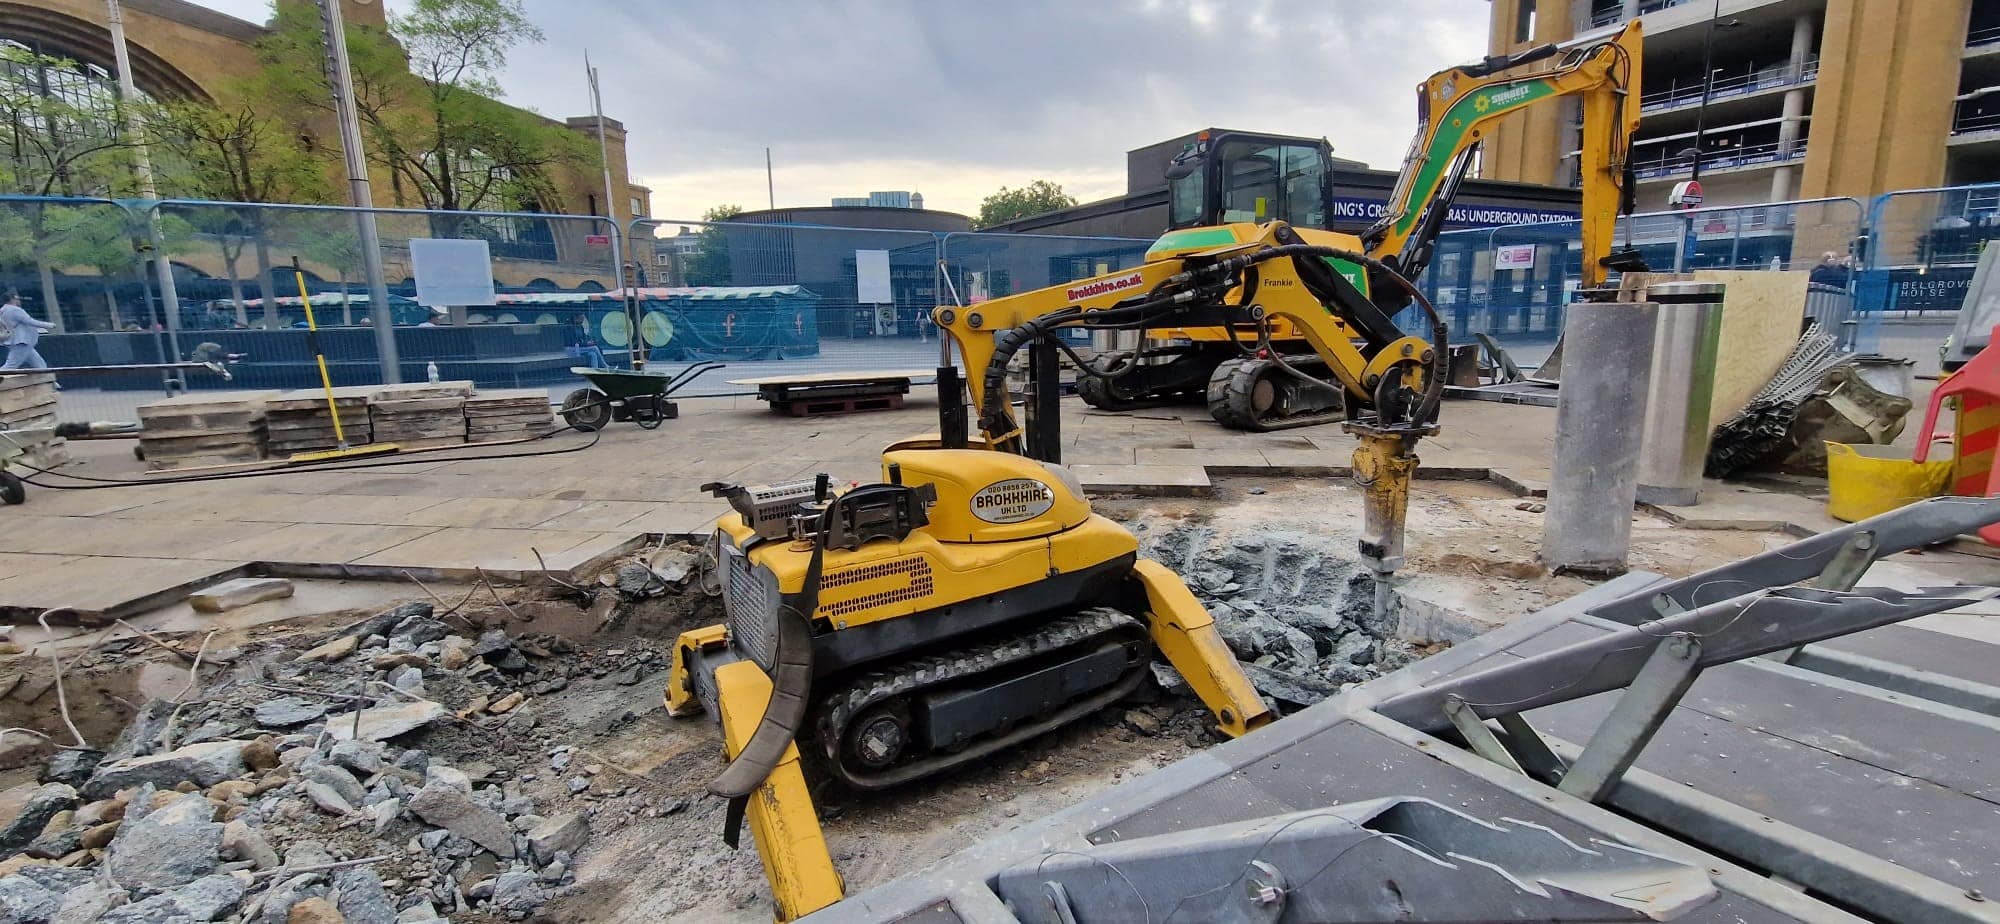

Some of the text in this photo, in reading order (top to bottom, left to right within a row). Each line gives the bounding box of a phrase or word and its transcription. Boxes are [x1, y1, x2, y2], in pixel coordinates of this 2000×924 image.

[1334, 201, 1364, 218] ING'S
[1469, 210, 1538, 224] UNDERGROUND
[1540, 214, 1573, 227] STATION
[1068, 274, 1142, 300] Brokkhire.co.uk
[1902, 280, 1972, 290] BELGROVE
[976, 488, 1049, 508] BROKKHIRE
[1013, 505, 1026, 513] LTD
